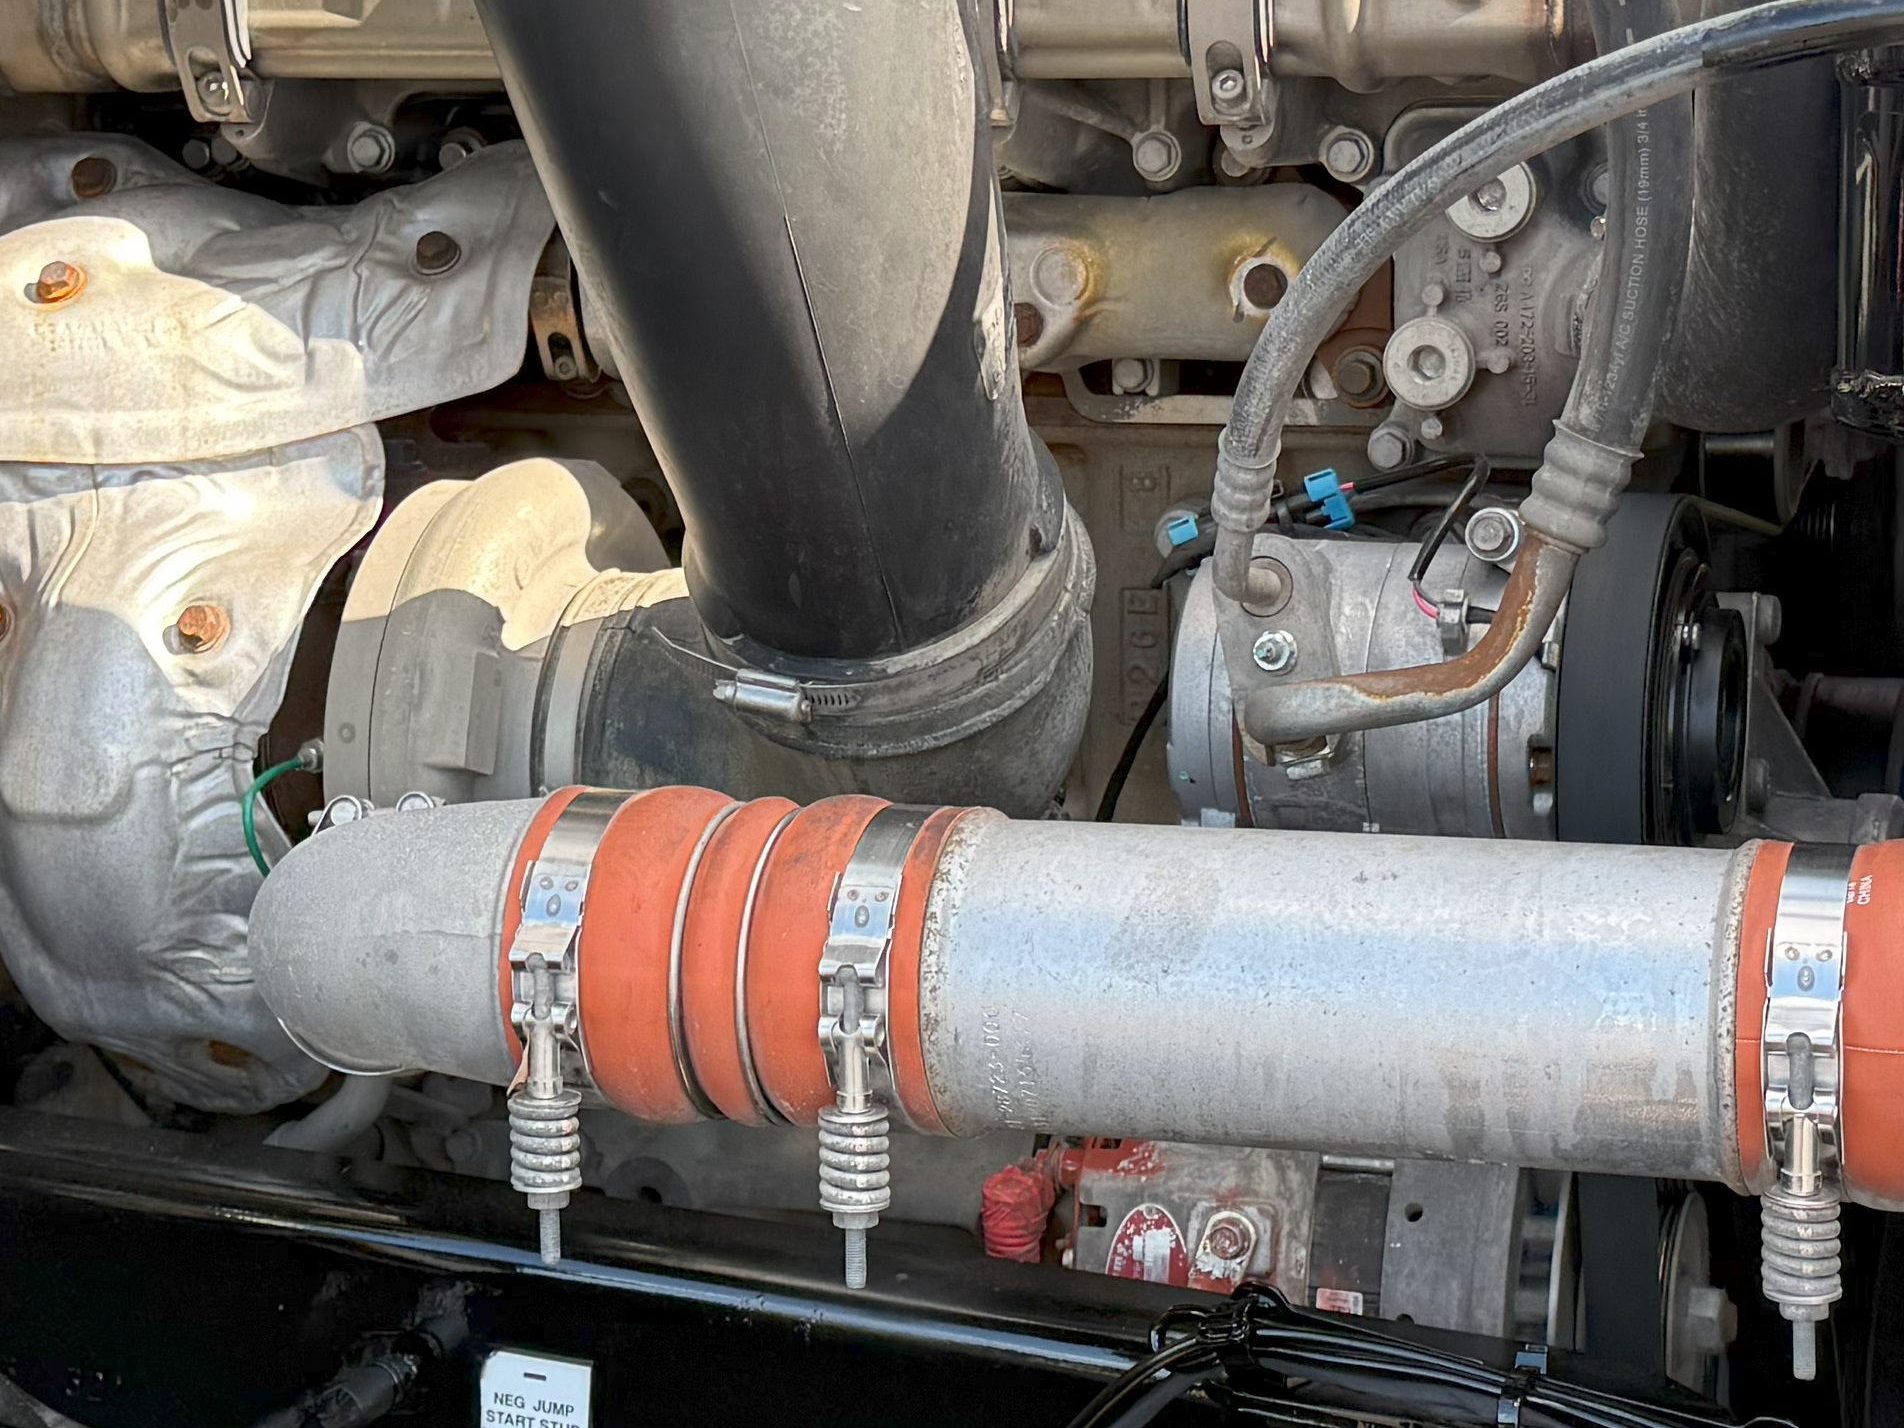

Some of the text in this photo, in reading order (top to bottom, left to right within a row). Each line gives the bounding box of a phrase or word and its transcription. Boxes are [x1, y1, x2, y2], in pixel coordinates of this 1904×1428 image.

[1637, 122, 1650, 143] 3/4
[1637, 148, 1652, 202] (19mm)
[1634, 206, 1649, 249] HOSE
[1622, 253, 1644, 321] SUCTION
[1616, 325, 1631, 349] A/C
[494, 1392, 575, 1417] NEG JUMP
